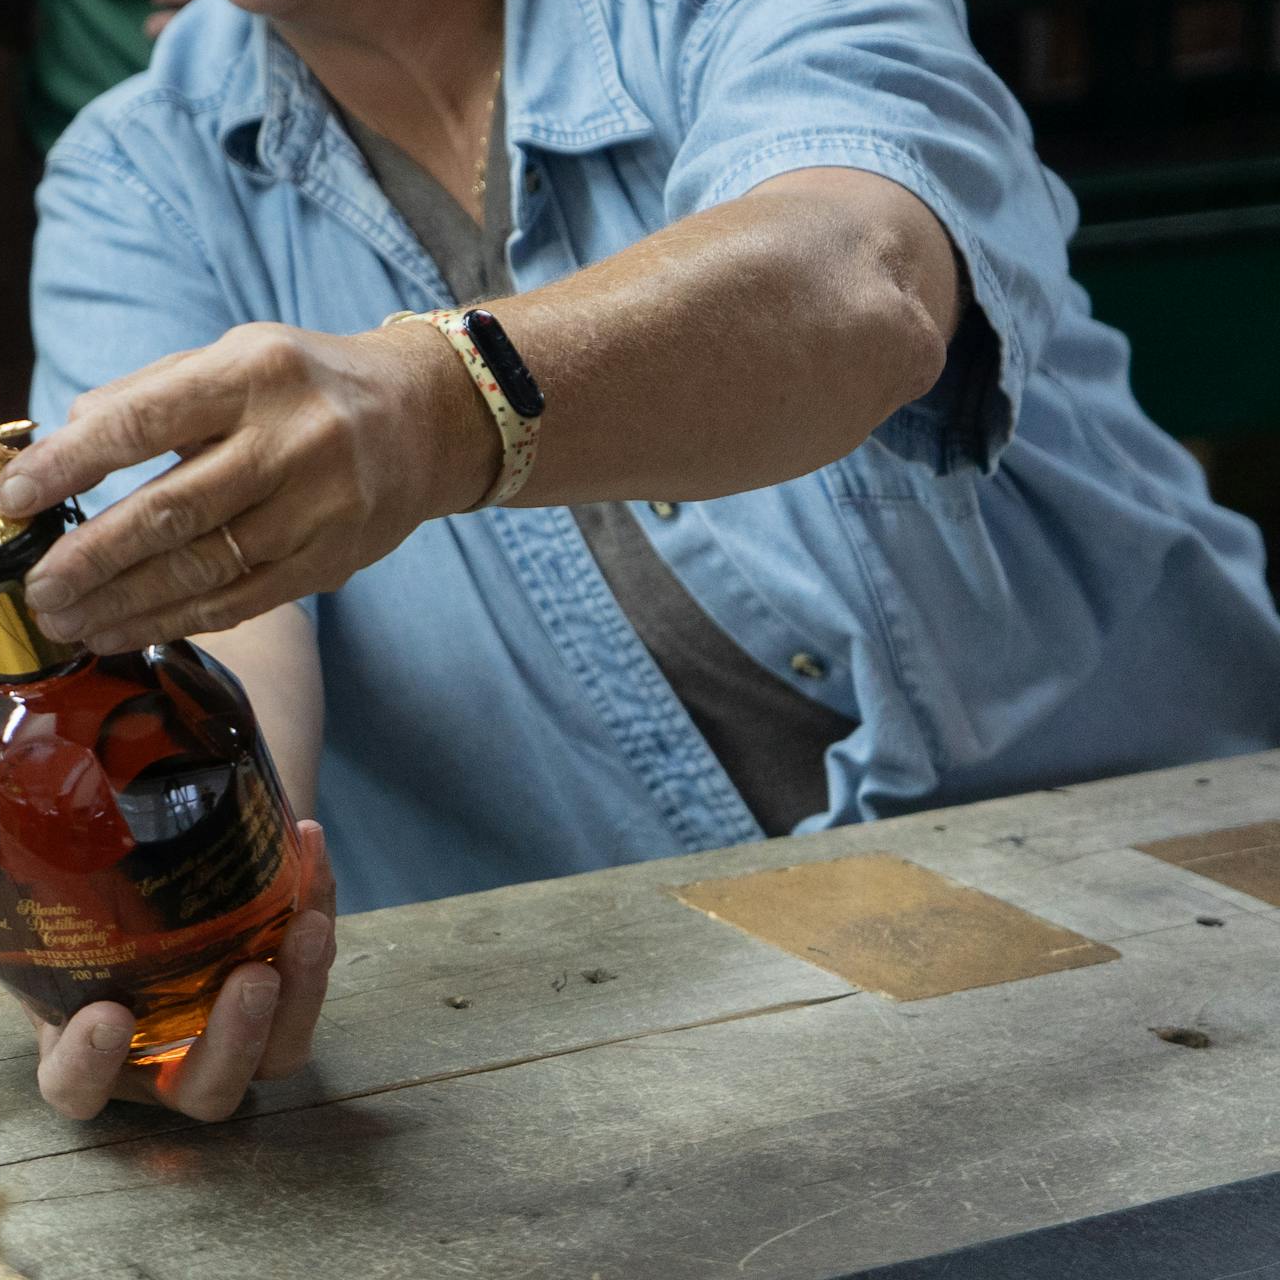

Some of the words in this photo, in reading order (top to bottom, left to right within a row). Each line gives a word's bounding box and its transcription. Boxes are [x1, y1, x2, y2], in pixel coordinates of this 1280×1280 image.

[16, 899, 81, 916] Blanton
[69, 969, 93, 981] 700
[95, 967, 112, 979] ml
